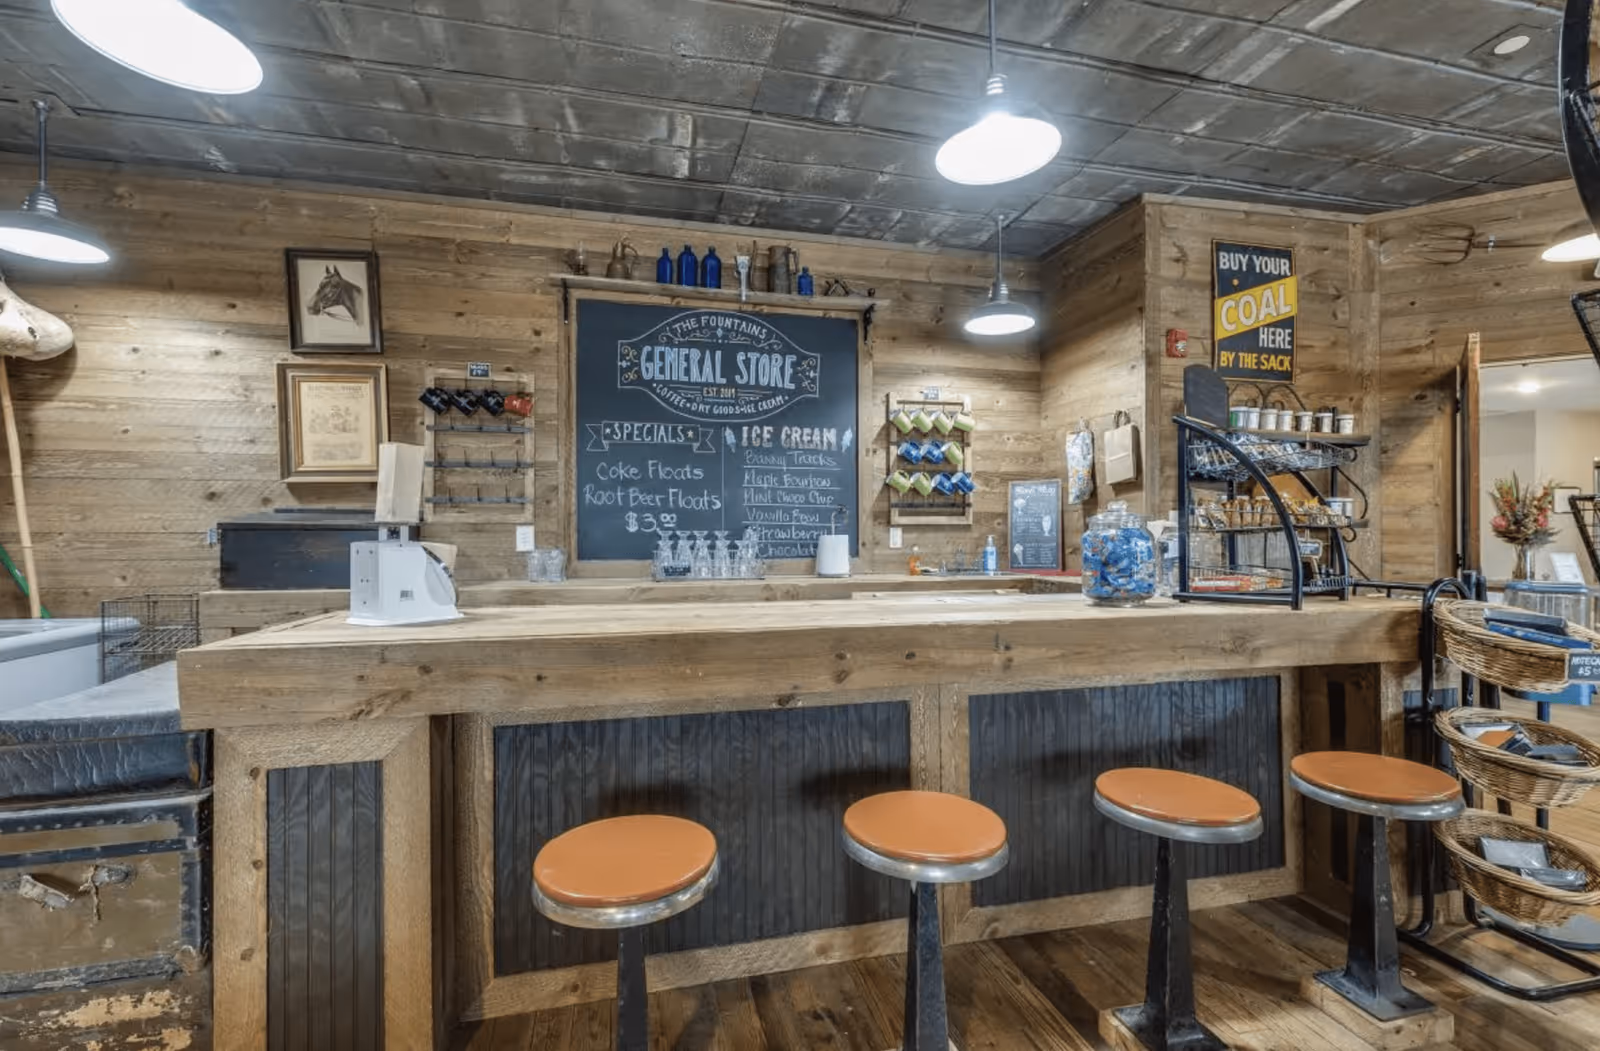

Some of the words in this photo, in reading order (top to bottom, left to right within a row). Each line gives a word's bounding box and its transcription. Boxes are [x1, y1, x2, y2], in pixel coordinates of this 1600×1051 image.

[1219, 251, 1249, 272] BUY
[1251, 255, 1291, 276] YOUR
[1221, 284, 1292, 331] COAL
[672, 318, 699, 333] THE
[701, 315, 768, 339] FOUNTAINS
[1259, 327, 1292, 349] HERE
[640, 345, 727, 384] GENERAL
[735, 351, 797, 390] STORE
[1219, 351, 1236, 367] BY
[1238, 352, 1258, 369] THE
[1260, 353, 1292, 371] SACK
[758, 395, 785, 412] CREAM
[613, 422, 685, 443] SPECIALS
[741, 425, 774, 448] ICE
[781, 425, 837, 451] CREAM
[596, 461, 642, 481] Coke
[647, 459, 705, 481] Floats
[583, 483, 626, 507] Root
[628, 487, 666, 508] Beer
[668, 488, 722, 511] Floats
[757, 543, 819, 558] Chocolat
